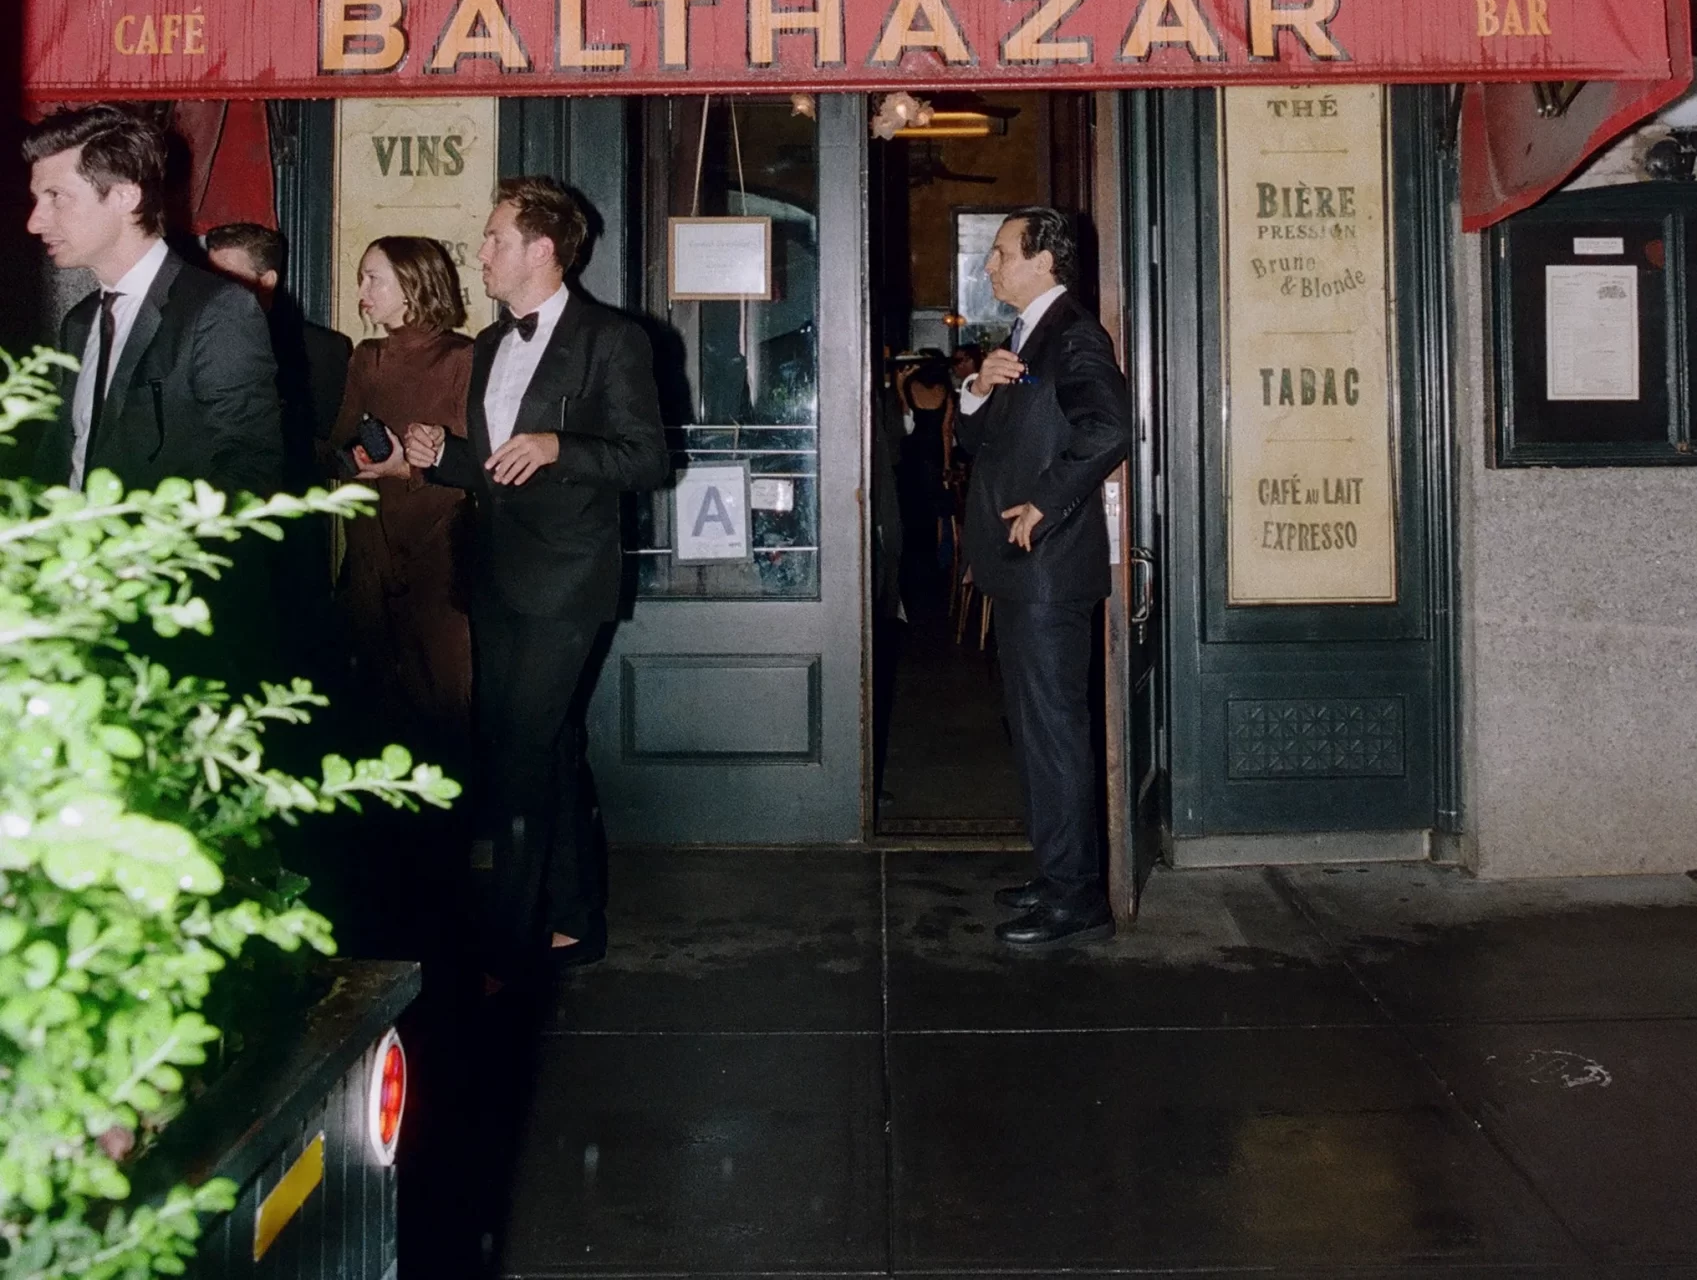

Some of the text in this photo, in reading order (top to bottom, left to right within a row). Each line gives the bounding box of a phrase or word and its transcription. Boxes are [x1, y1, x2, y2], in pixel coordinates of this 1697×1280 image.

[113, 6, 206, 56] CAFÉ
[1267, 94, 1338, 118] THÉ
[371, 134, 465, 177] VINS
[1256, 180, 1356, 219] BIÈRE
[1257, 224, 1356, 240] PRESSION
[1250, 255, 1316, 280] Brune
[1280, 267, 1366, 299] & Blonde
[1259, 367, 1360, 407] TABAC
[1257, 473, 1363, 506] CAFÉ AU LAIT
[691, 485, 736, 537] A
[1261, 520, 1357, 552] EXPRESSO
